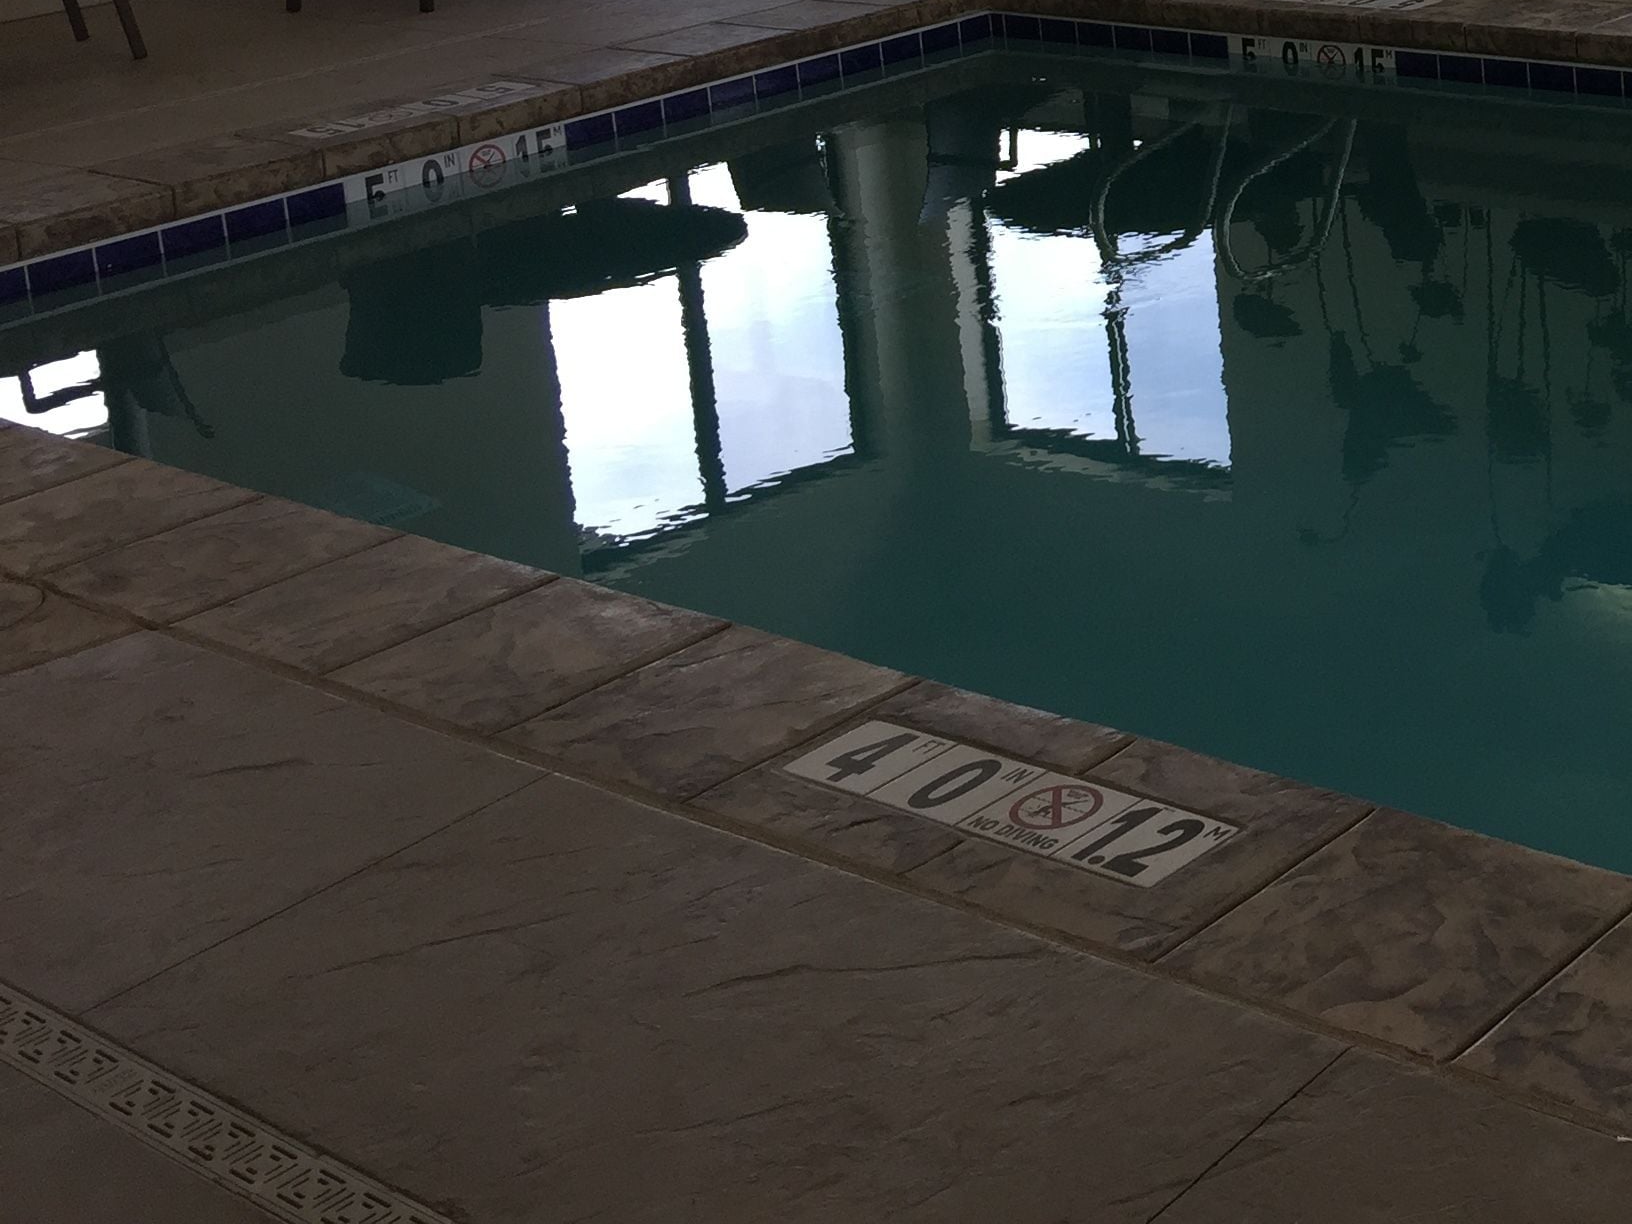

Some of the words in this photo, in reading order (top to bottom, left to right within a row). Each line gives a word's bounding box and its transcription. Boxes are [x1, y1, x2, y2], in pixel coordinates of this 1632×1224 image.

[388, 169, 398, 183] FT
[444, 153, 456, 168] IN
[825, 733, 920, 782] 4
[912, 740, 946, 755] FT
[907, 759, 1002, 809] 0
[1001, 767, 1034, 784] IN
[967, 815, 997, 832] NO
[995, 823, 1061, 851] DIVING
[1071, 807, 1205, 878] 1.2
[1203, 826, 1228, 841] M
